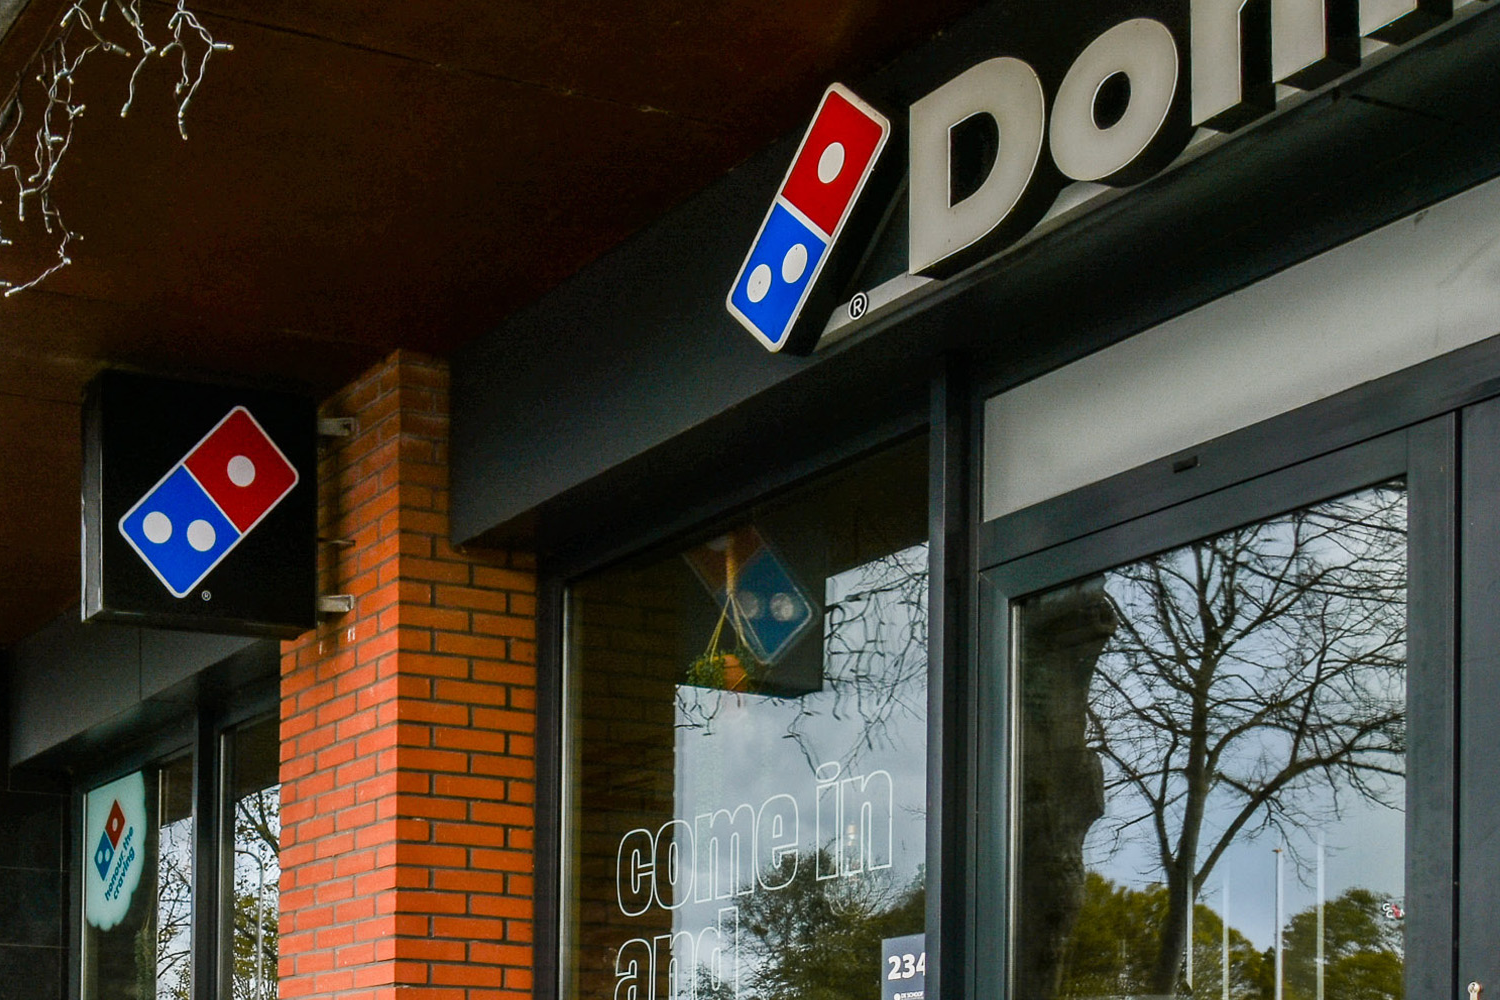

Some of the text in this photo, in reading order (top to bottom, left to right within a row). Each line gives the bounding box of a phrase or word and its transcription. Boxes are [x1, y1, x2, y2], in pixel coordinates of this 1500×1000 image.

[104, 826, 135, 901] honour the
[113, 846, 136, 900] craving
[616, 761, 893, 917] come in
